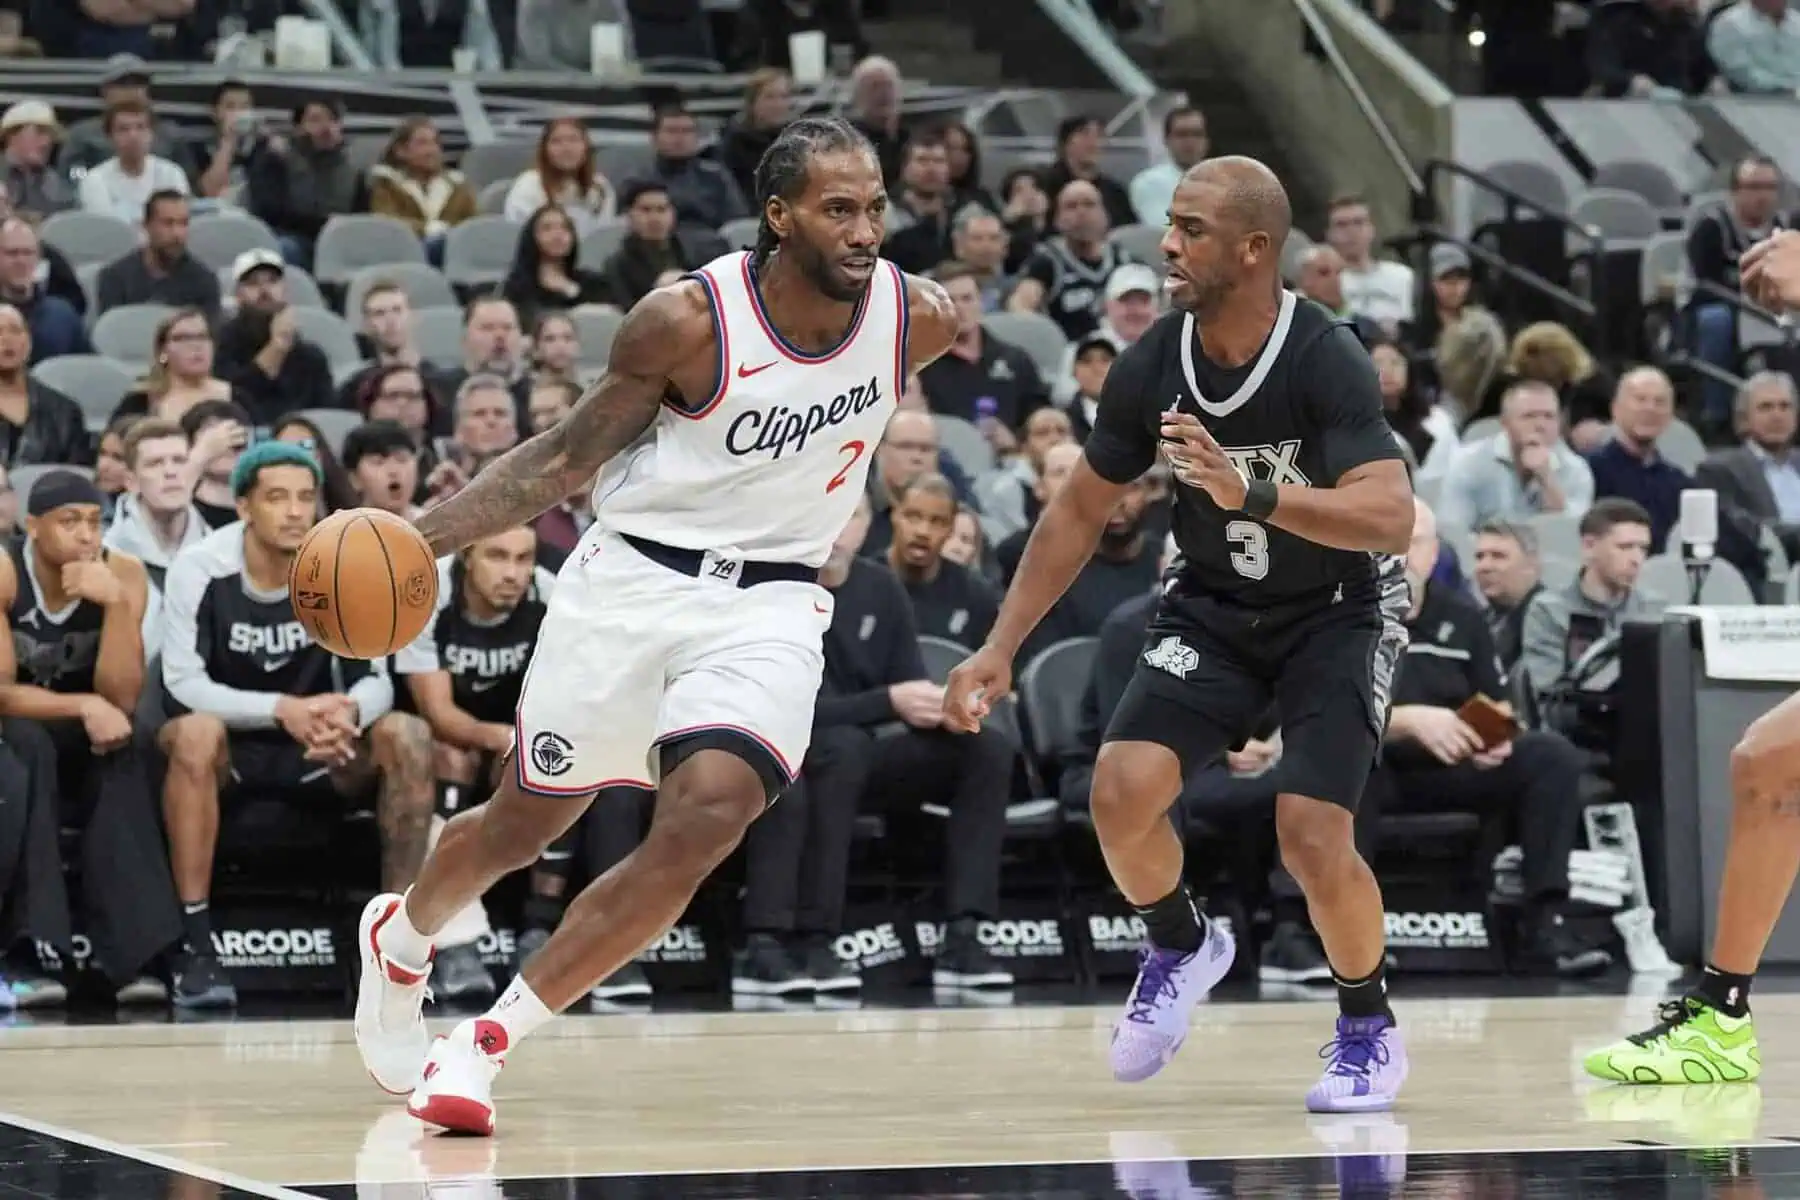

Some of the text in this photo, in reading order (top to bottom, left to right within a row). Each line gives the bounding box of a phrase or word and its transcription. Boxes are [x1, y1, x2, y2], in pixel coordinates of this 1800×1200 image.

[725, 375, 882, 460] Clippers
[826, 440, 865, 495] 2
[1225, 520, 1269, 581] 3
[228, 621, 315, 656] SPUR
